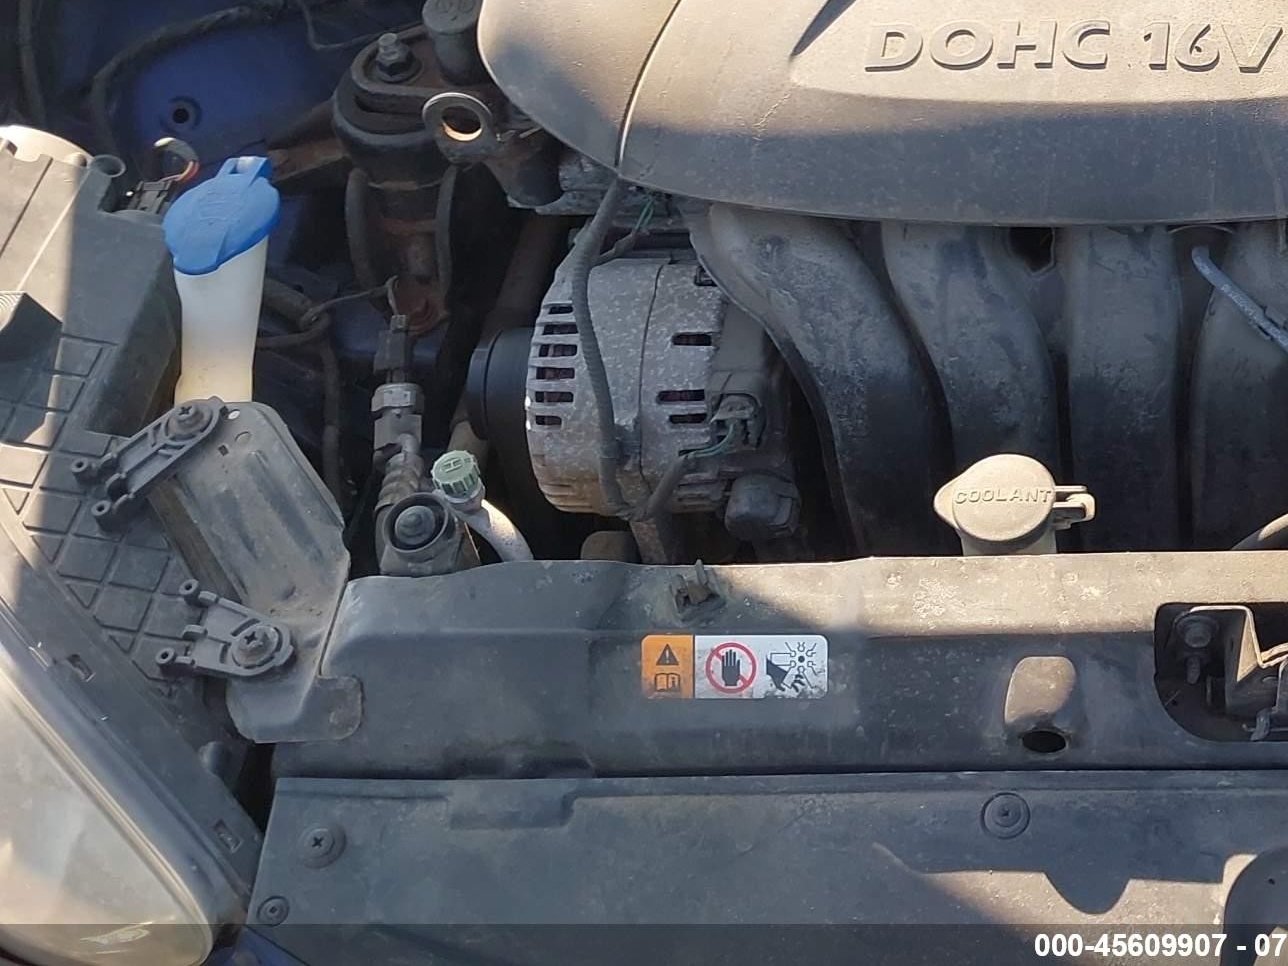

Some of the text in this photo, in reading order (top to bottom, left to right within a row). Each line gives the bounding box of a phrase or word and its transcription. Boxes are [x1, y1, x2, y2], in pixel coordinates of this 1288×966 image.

[864, 20, 1284, 73] DOHC 16V
[954, 488, 1053, 504] COOLANT
